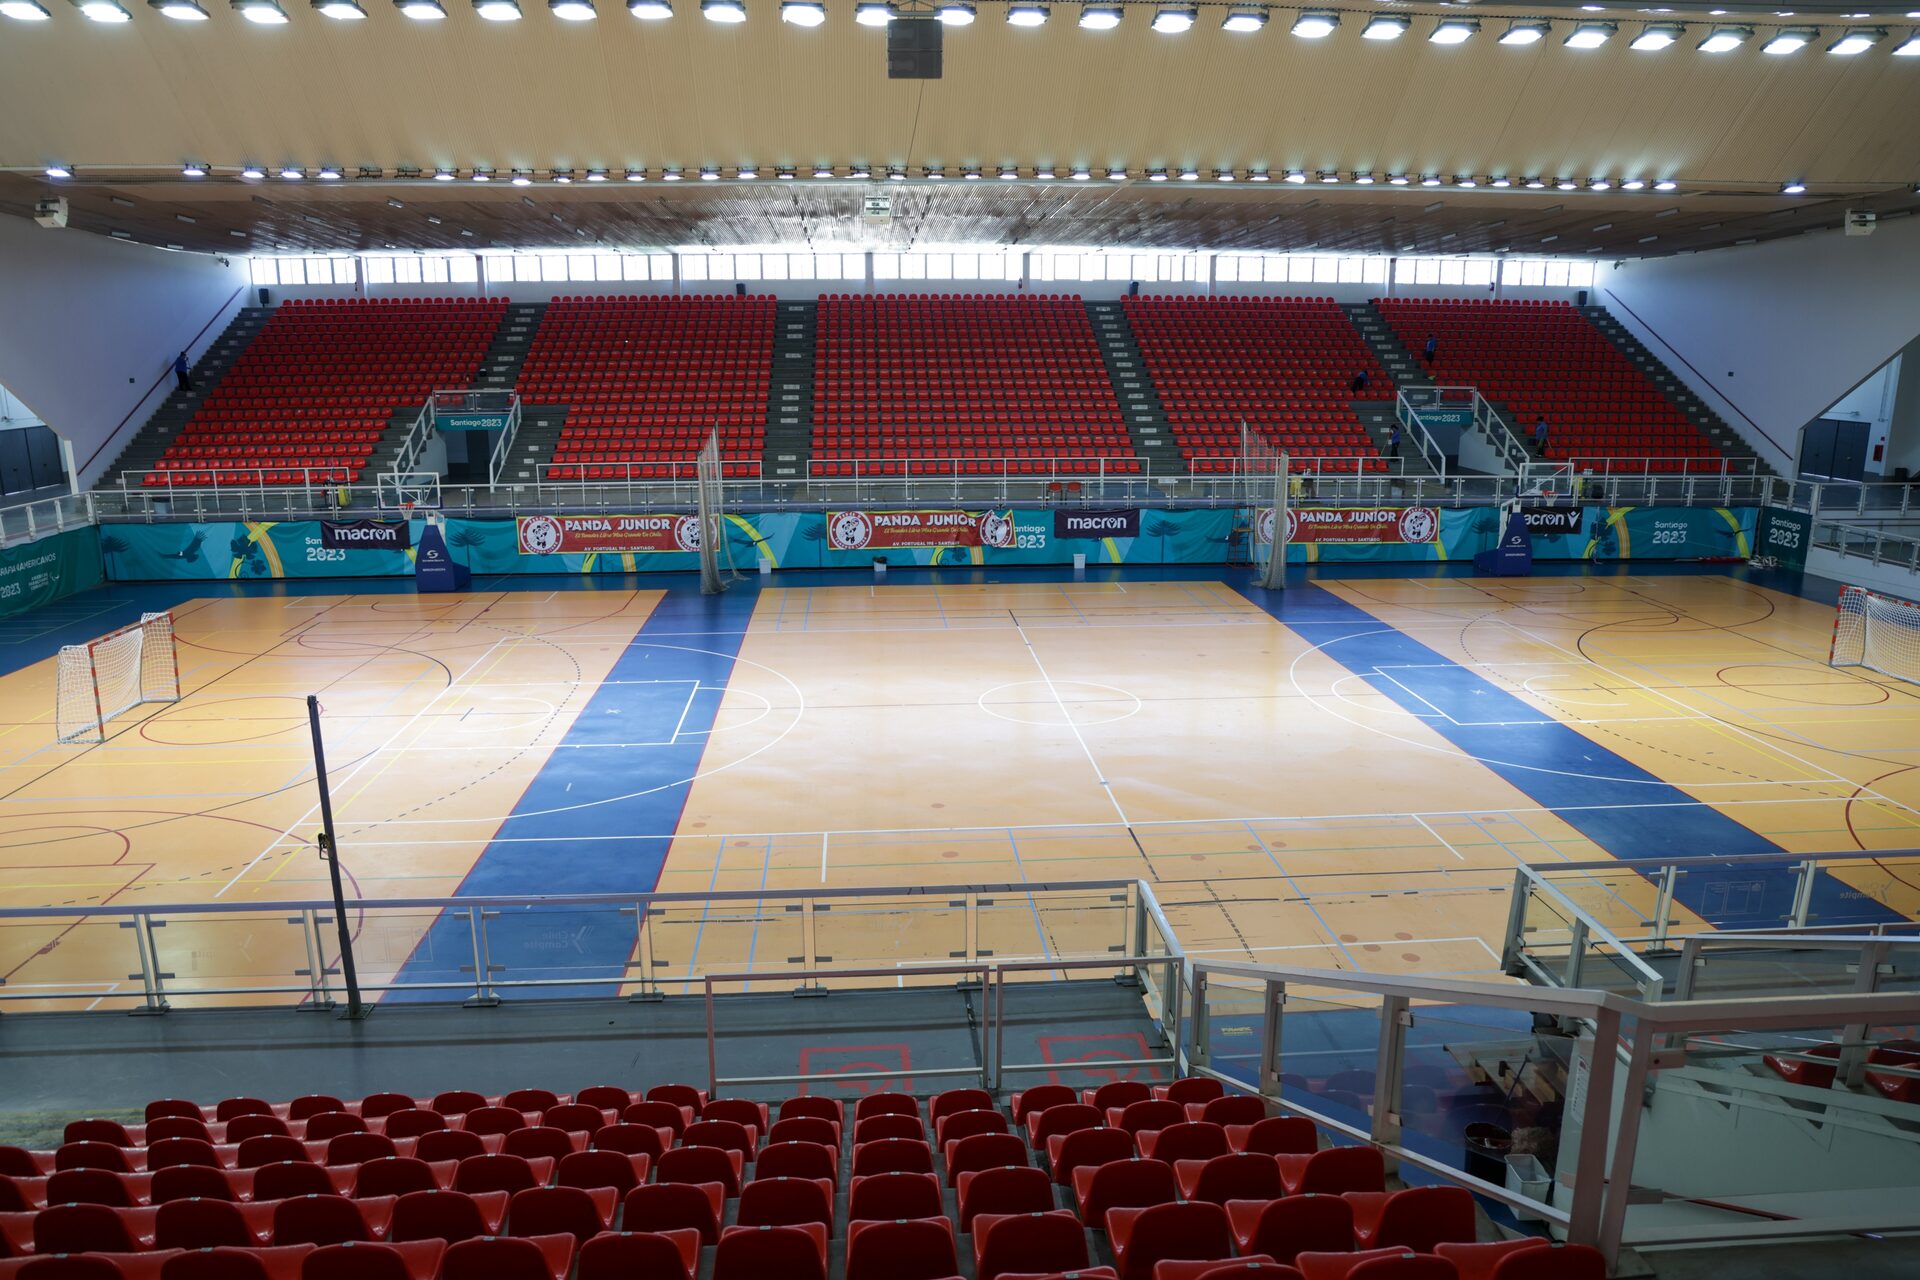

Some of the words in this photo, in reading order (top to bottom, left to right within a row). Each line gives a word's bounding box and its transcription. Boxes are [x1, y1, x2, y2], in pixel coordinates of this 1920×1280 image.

[450, 419, 481, 427] Santiago
[481, 418, 502, 427] 2023
[874, 515, 921, 526] PANDA
[926, 514, 977, 527] JUNIOR
[1067, 517, 1127, 529] macron
[1300, 511, 1344, 522] PANDA
[1348, 511, 1396, 522] JUNIOR
[565, 519, 611, 531] PANDA
[617, 518, 671, 530] JUNIOR
[1015, 525, 1046, 533] antiago
[1654, 521, 1688, 530] Santiago
[1771, 517, 1801, 531] Santiago
[334, 528, 397, 541] macron
[1018, 534, 1046, 548] 023
[1652, 530, 1687, 544] 2023
[1769, 528, 1800, 548] 2023
[306, 547, 346, 561] 2023
